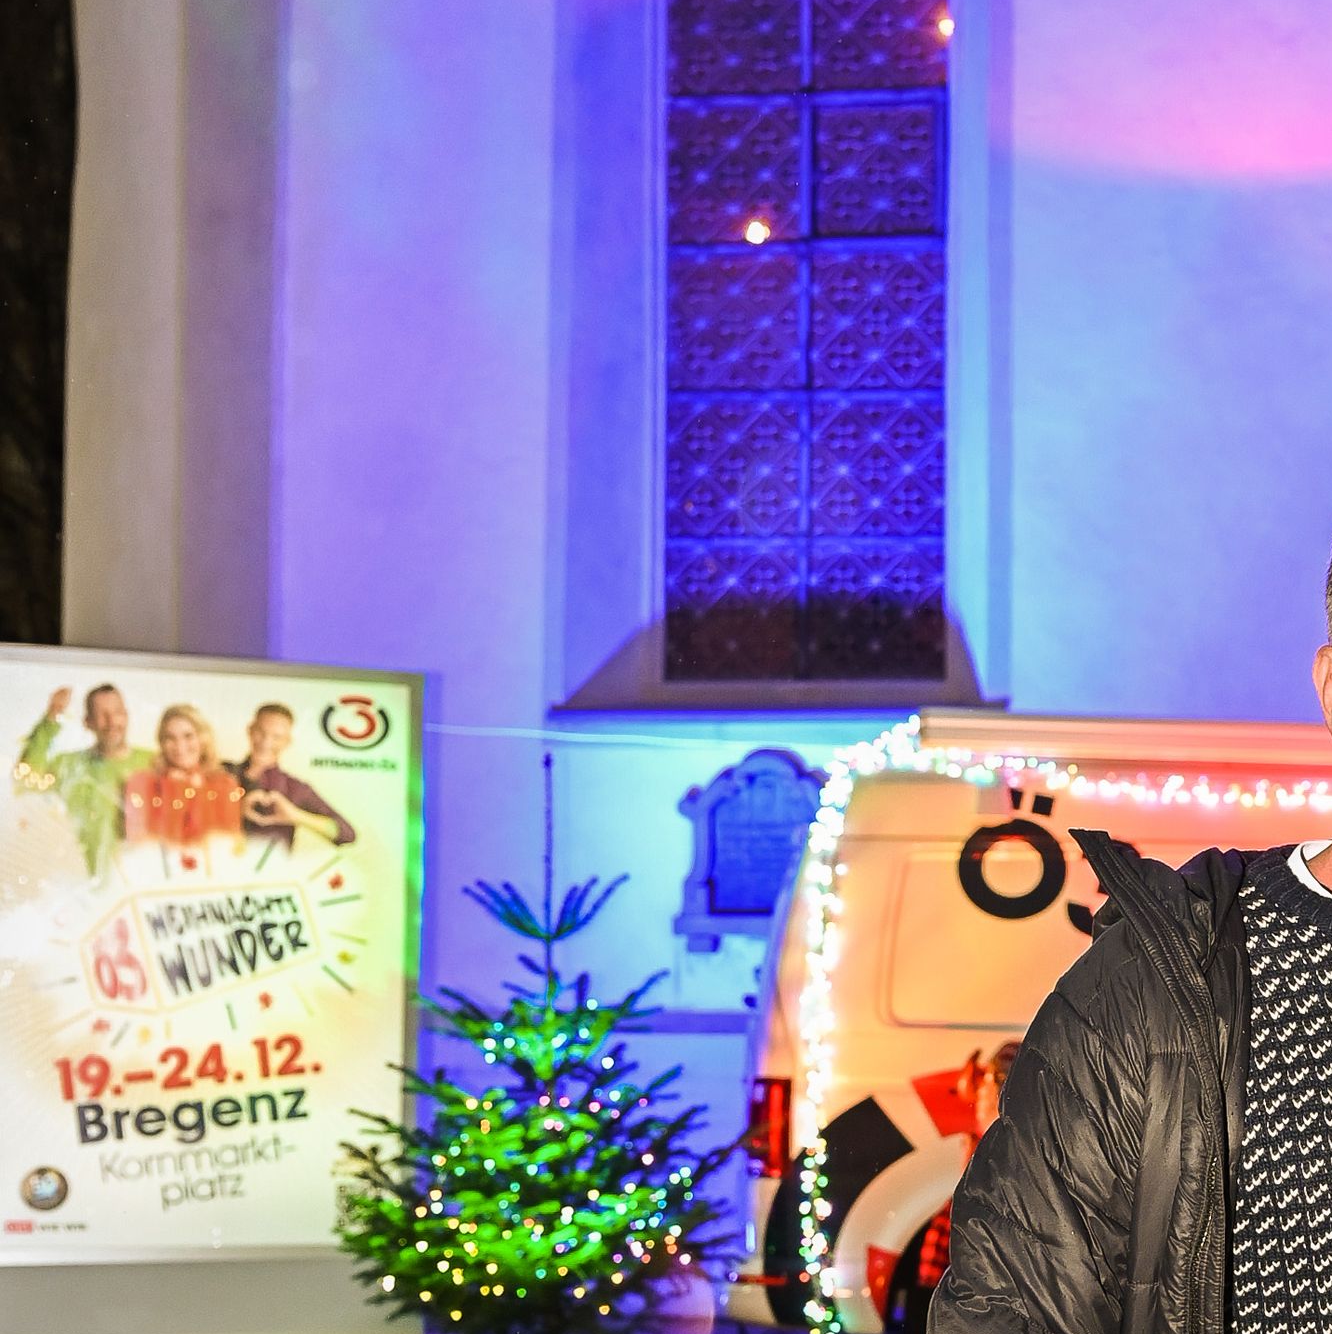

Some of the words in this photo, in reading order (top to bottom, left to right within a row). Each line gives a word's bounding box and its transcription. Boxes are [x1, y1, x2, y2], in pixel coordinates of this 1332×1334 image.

[159, 920, 308, 995] WUNDER
[77, 1087, 309, 1144] Bregenz
[99, 1134, 297, 1184] Kornmarkt-
[160, 1173, 246, 1211] platz
